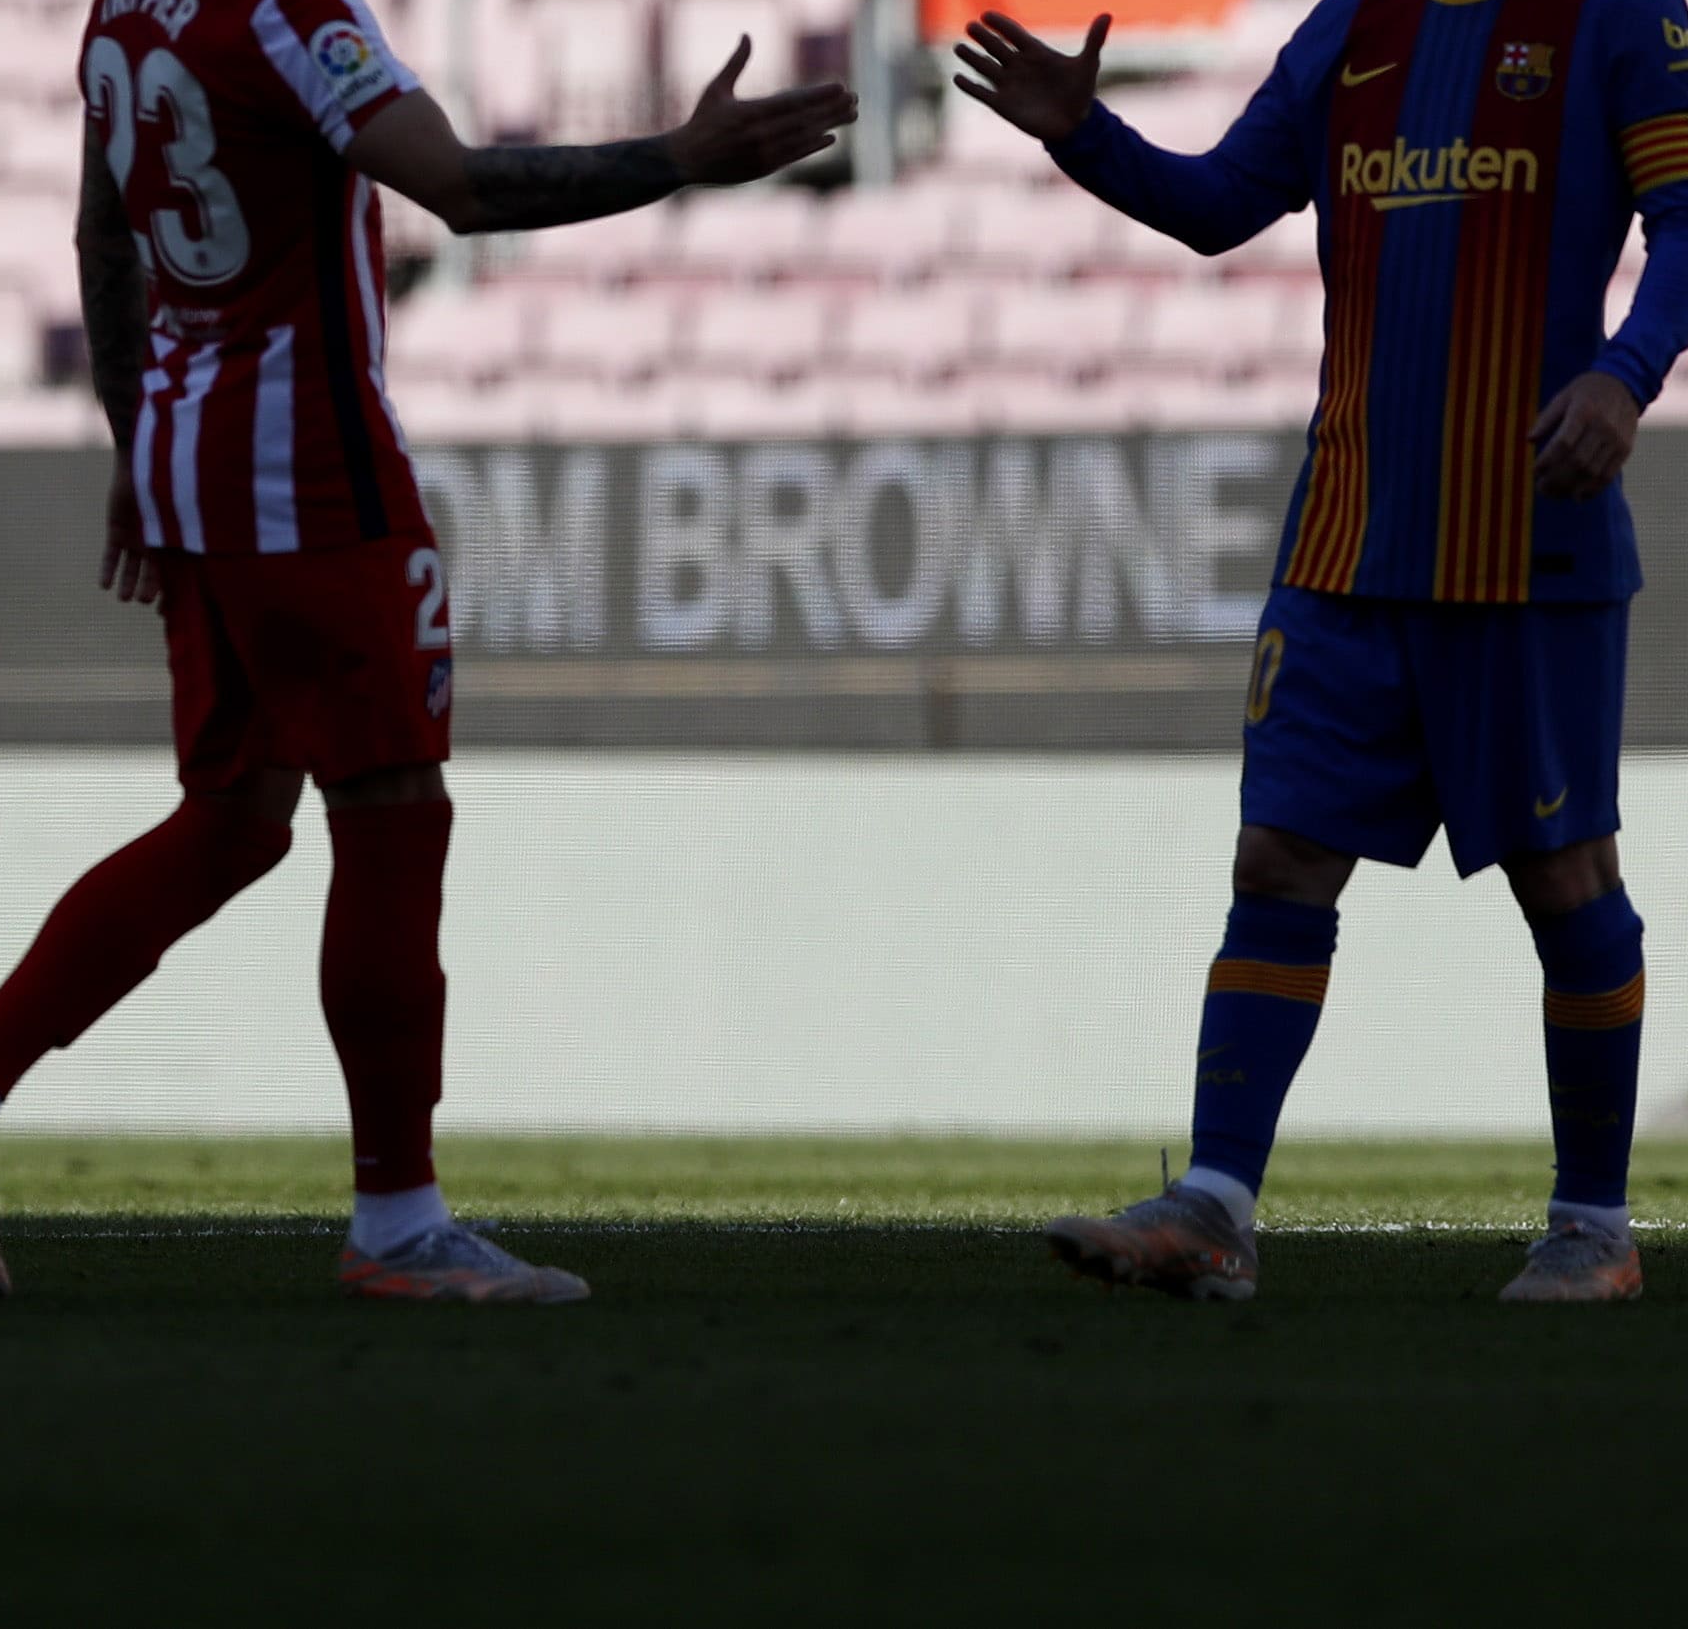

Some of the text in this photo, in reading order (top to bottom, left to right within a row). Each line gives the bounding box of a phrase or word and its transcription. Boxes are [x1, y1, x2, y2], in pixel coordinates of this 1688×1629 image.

[82, 35, 253, 288] 23
[1339, 135, 1540, 198] Rakuten
[636, 439, 1277, 652] BROWNE
